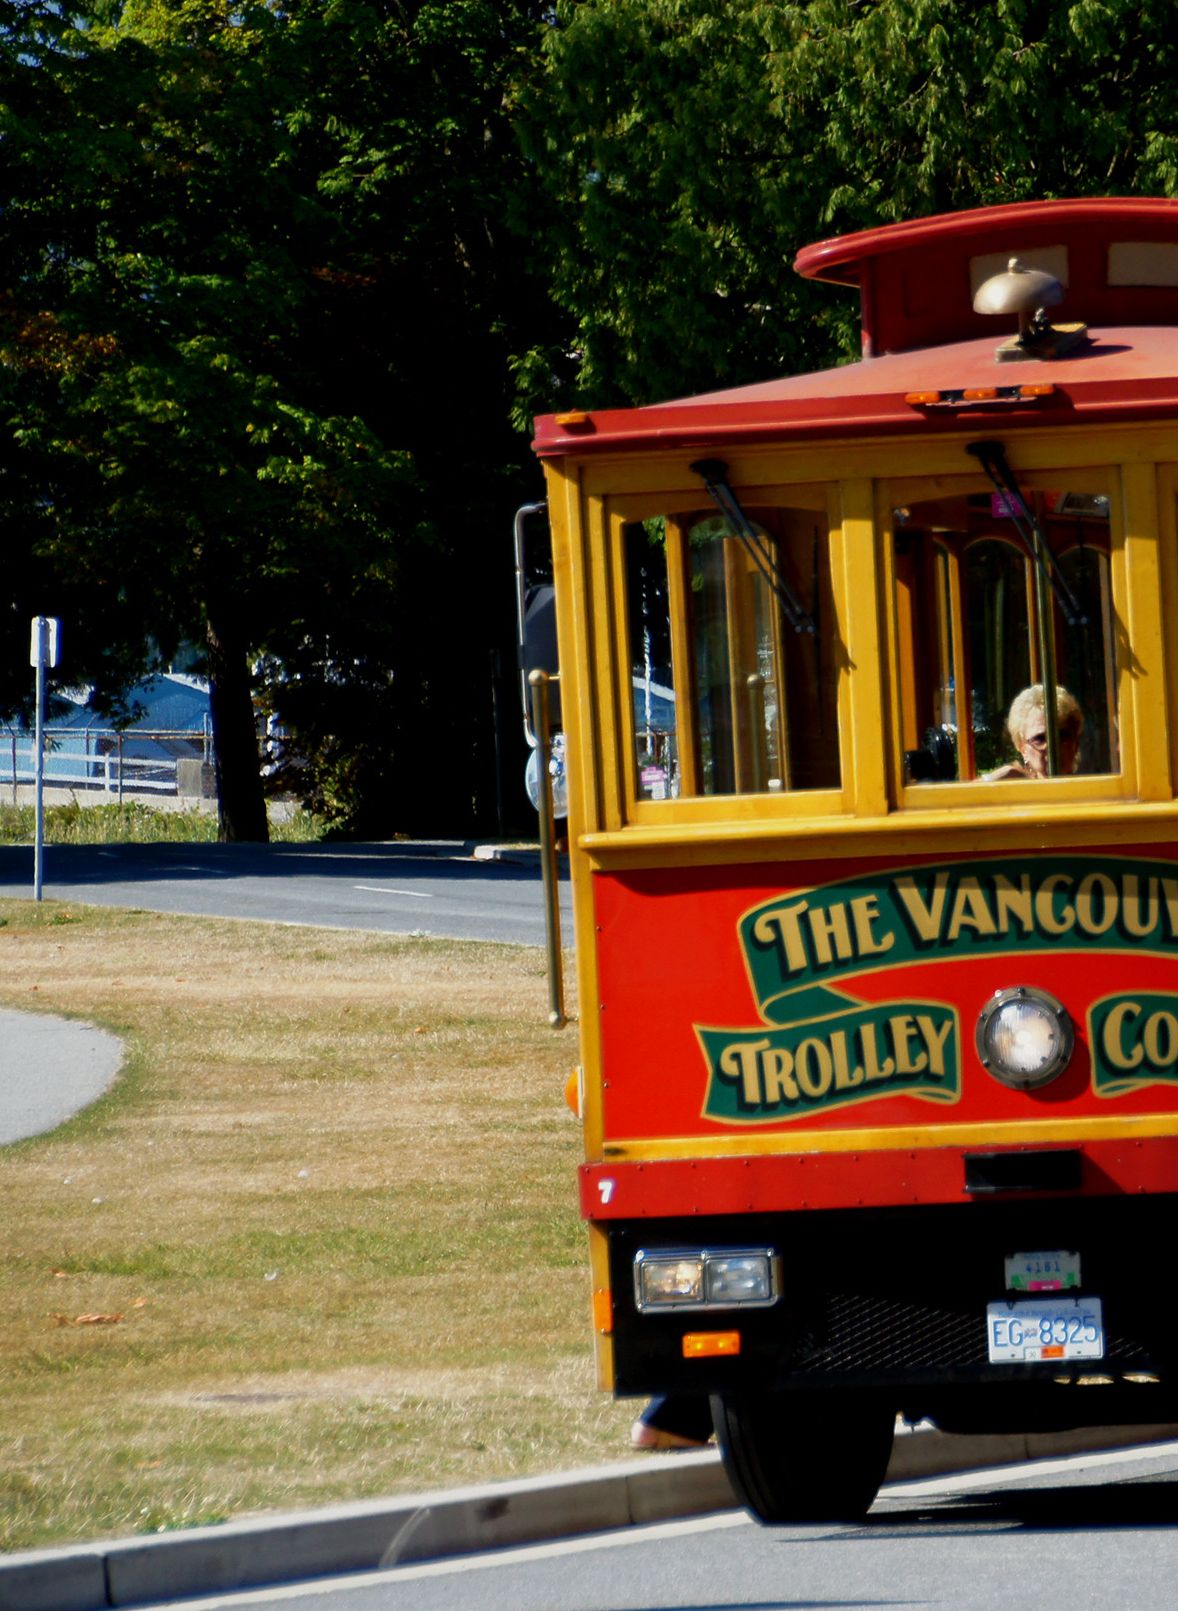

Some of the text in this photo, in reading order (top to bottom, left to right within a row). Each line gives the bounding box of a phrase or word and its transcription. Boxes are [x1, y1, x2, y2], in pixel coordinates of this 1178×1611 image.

[753, 893, 895, 974] THE
[720, 1014, 954, 1104] TROLLEY
[598, 1181, 613, 1204] 7
[993, 1315, 1099, 1347] EG 8325
